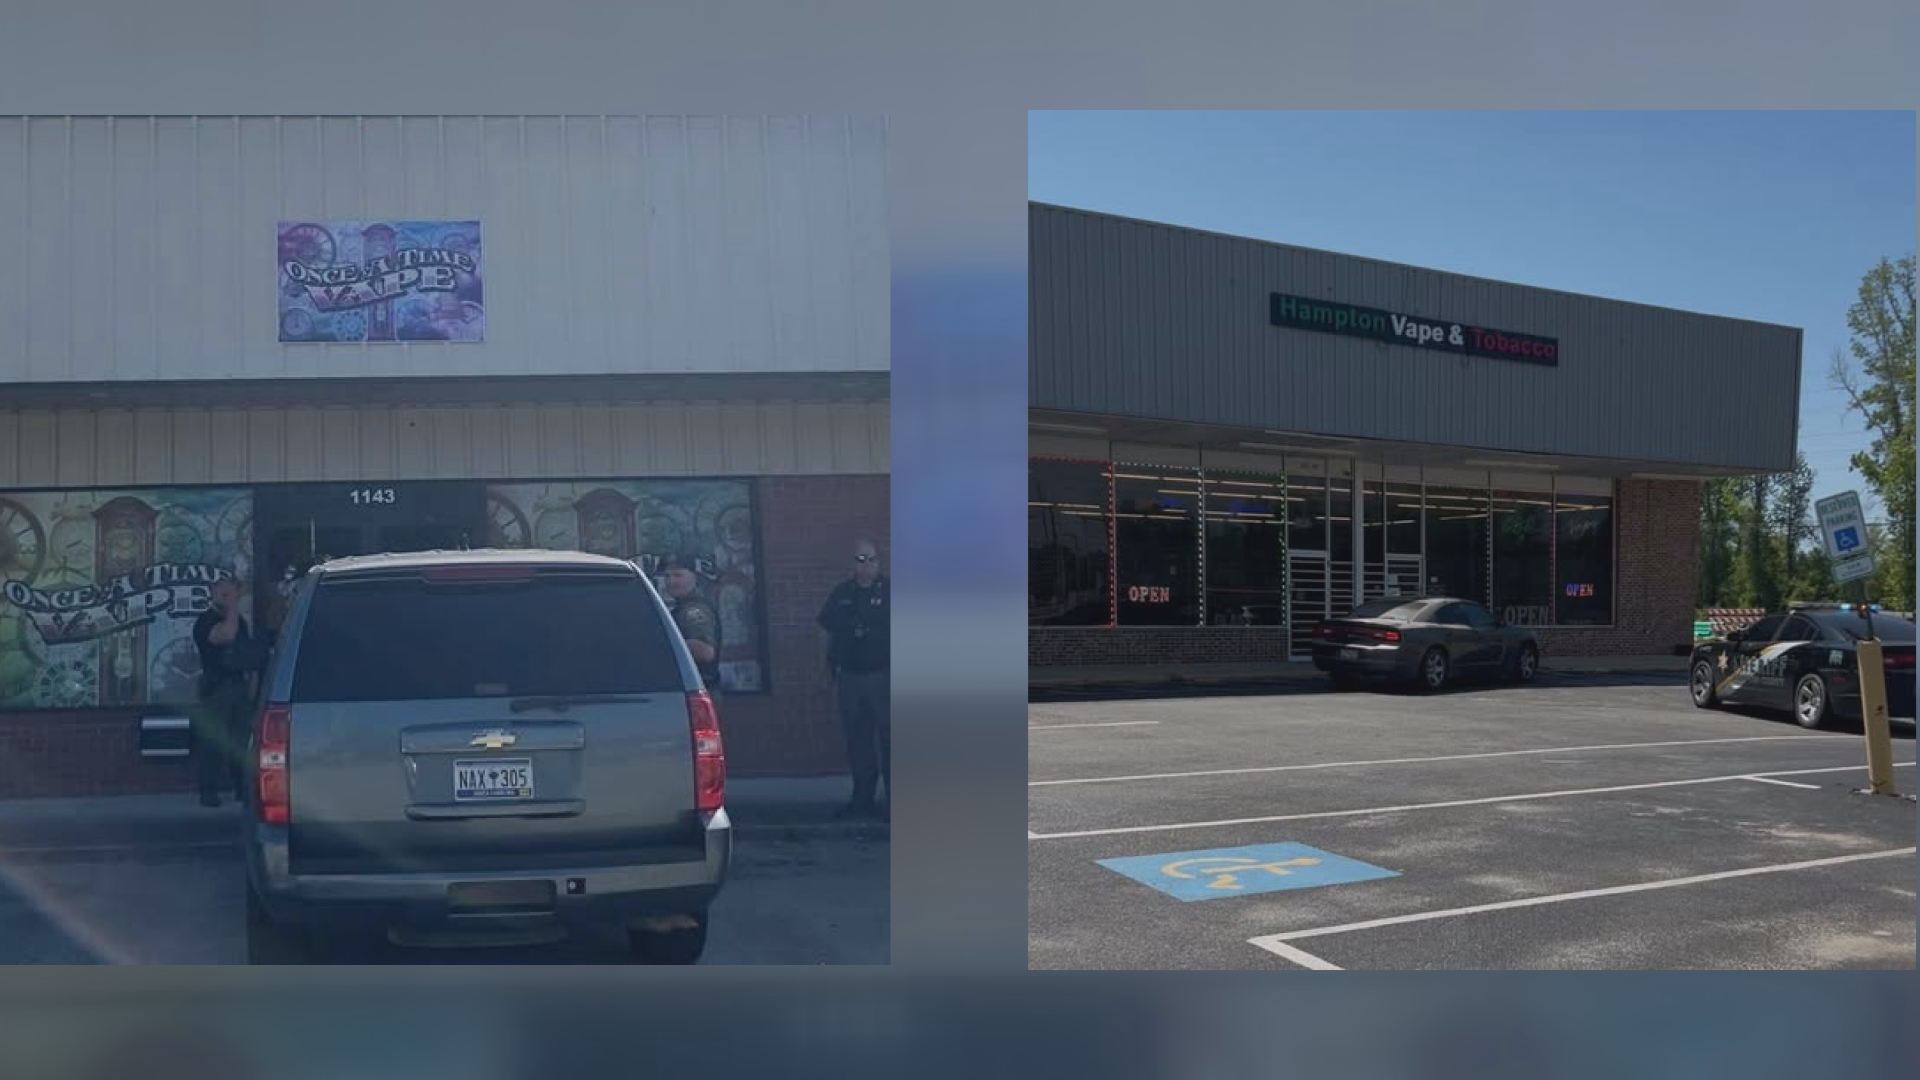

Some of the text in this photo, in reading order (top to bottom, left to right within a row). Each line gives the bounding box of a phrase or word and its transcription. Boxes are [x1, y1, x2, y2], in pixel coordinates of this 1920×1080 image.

[285, 261, 359, 287] ONCE
[399, 249, 474, 273] TIME
[303, 266, 456, 311] VAPE
[1280, 297, 1557, 357] Hampton Vape & Tobacco
[350, 489, 395, 504] 1143
[4, 580, 98, 610] ONCE
[145, 564, 235, 583] TIME
[1128, 586, 1170, 603] OPEN
[1565, 583, 1594, 597] OPEN
[27, 585, 213, 645] VAPE
[1504, 606, 1549, 626] OPEN
[460, 769, 527, 789] NAX 305
